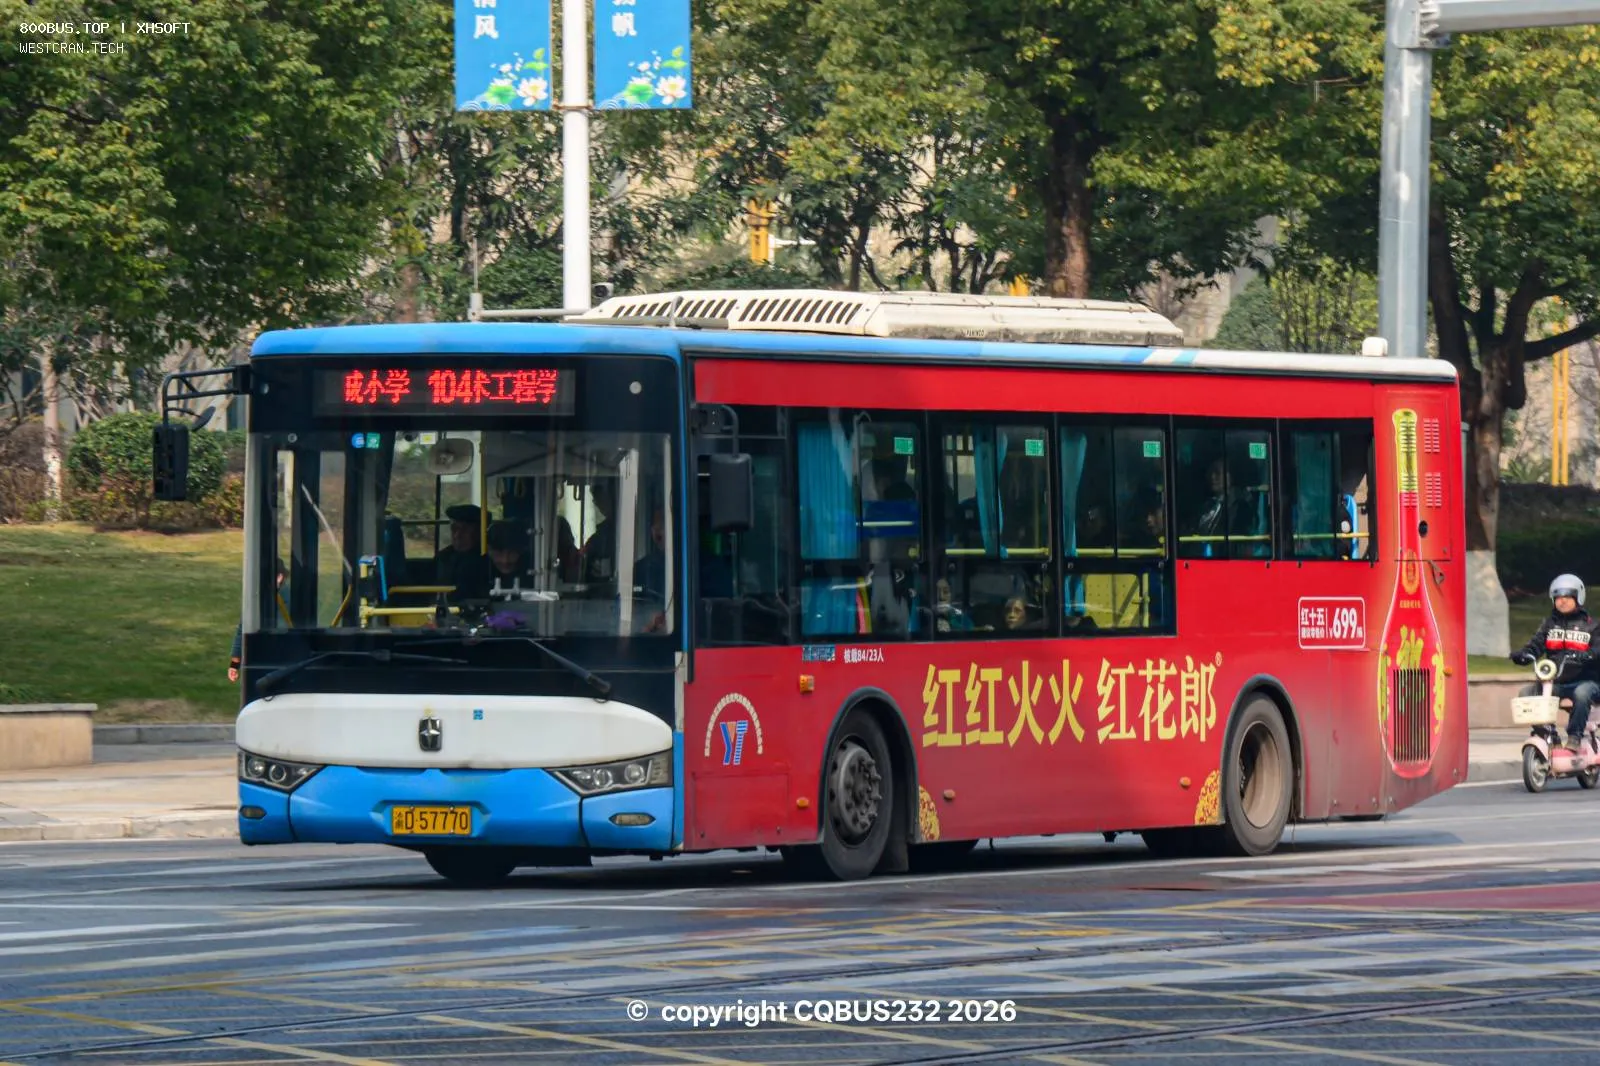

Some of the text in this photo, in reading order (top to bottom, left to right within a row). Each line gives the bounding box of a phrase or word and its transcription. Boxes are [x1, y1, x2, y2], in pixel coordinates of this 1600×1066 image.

[1300, 607, 1325, 626] 红十五
[921, 658, 1085, 749] 红红火火
